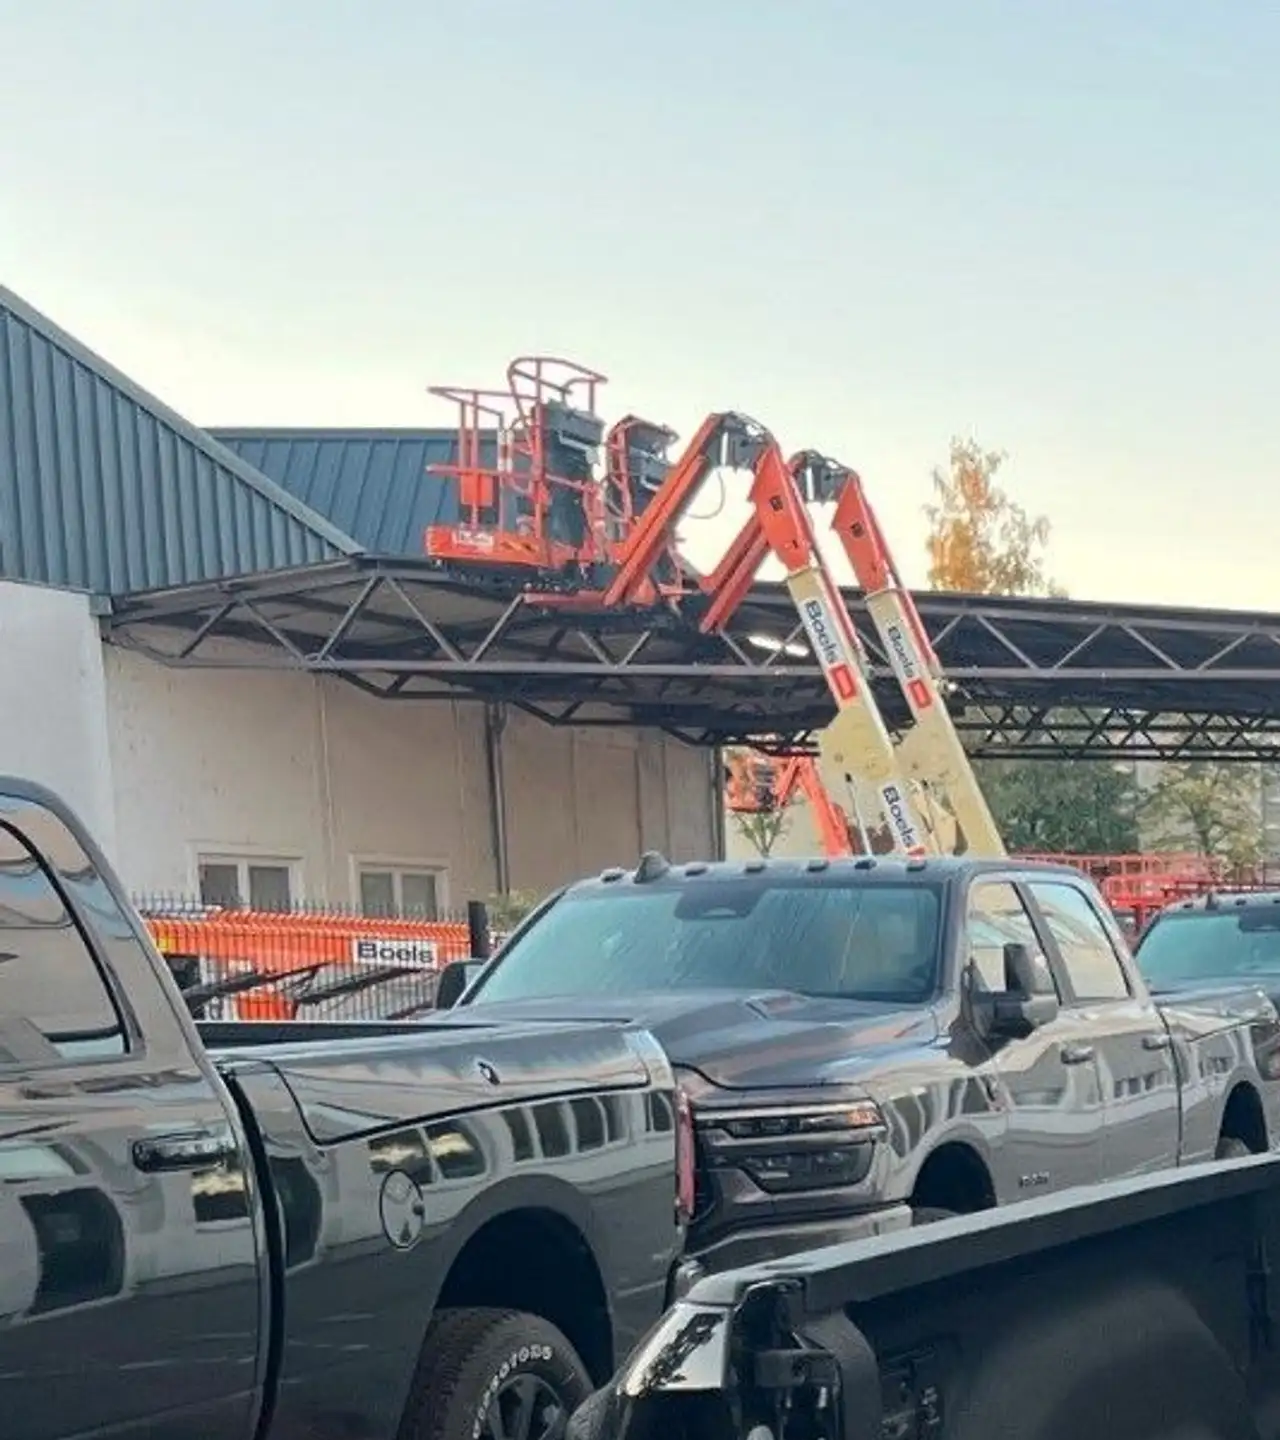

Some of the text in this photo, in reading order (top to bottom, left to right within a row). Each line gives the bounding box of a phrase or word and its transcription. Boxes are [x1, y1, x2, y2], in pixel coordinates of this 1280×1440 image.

[804, 600, 839, 664] Boels
[883, 786, 916, 848] Boels
[358, 942, 433, 963] Boels
